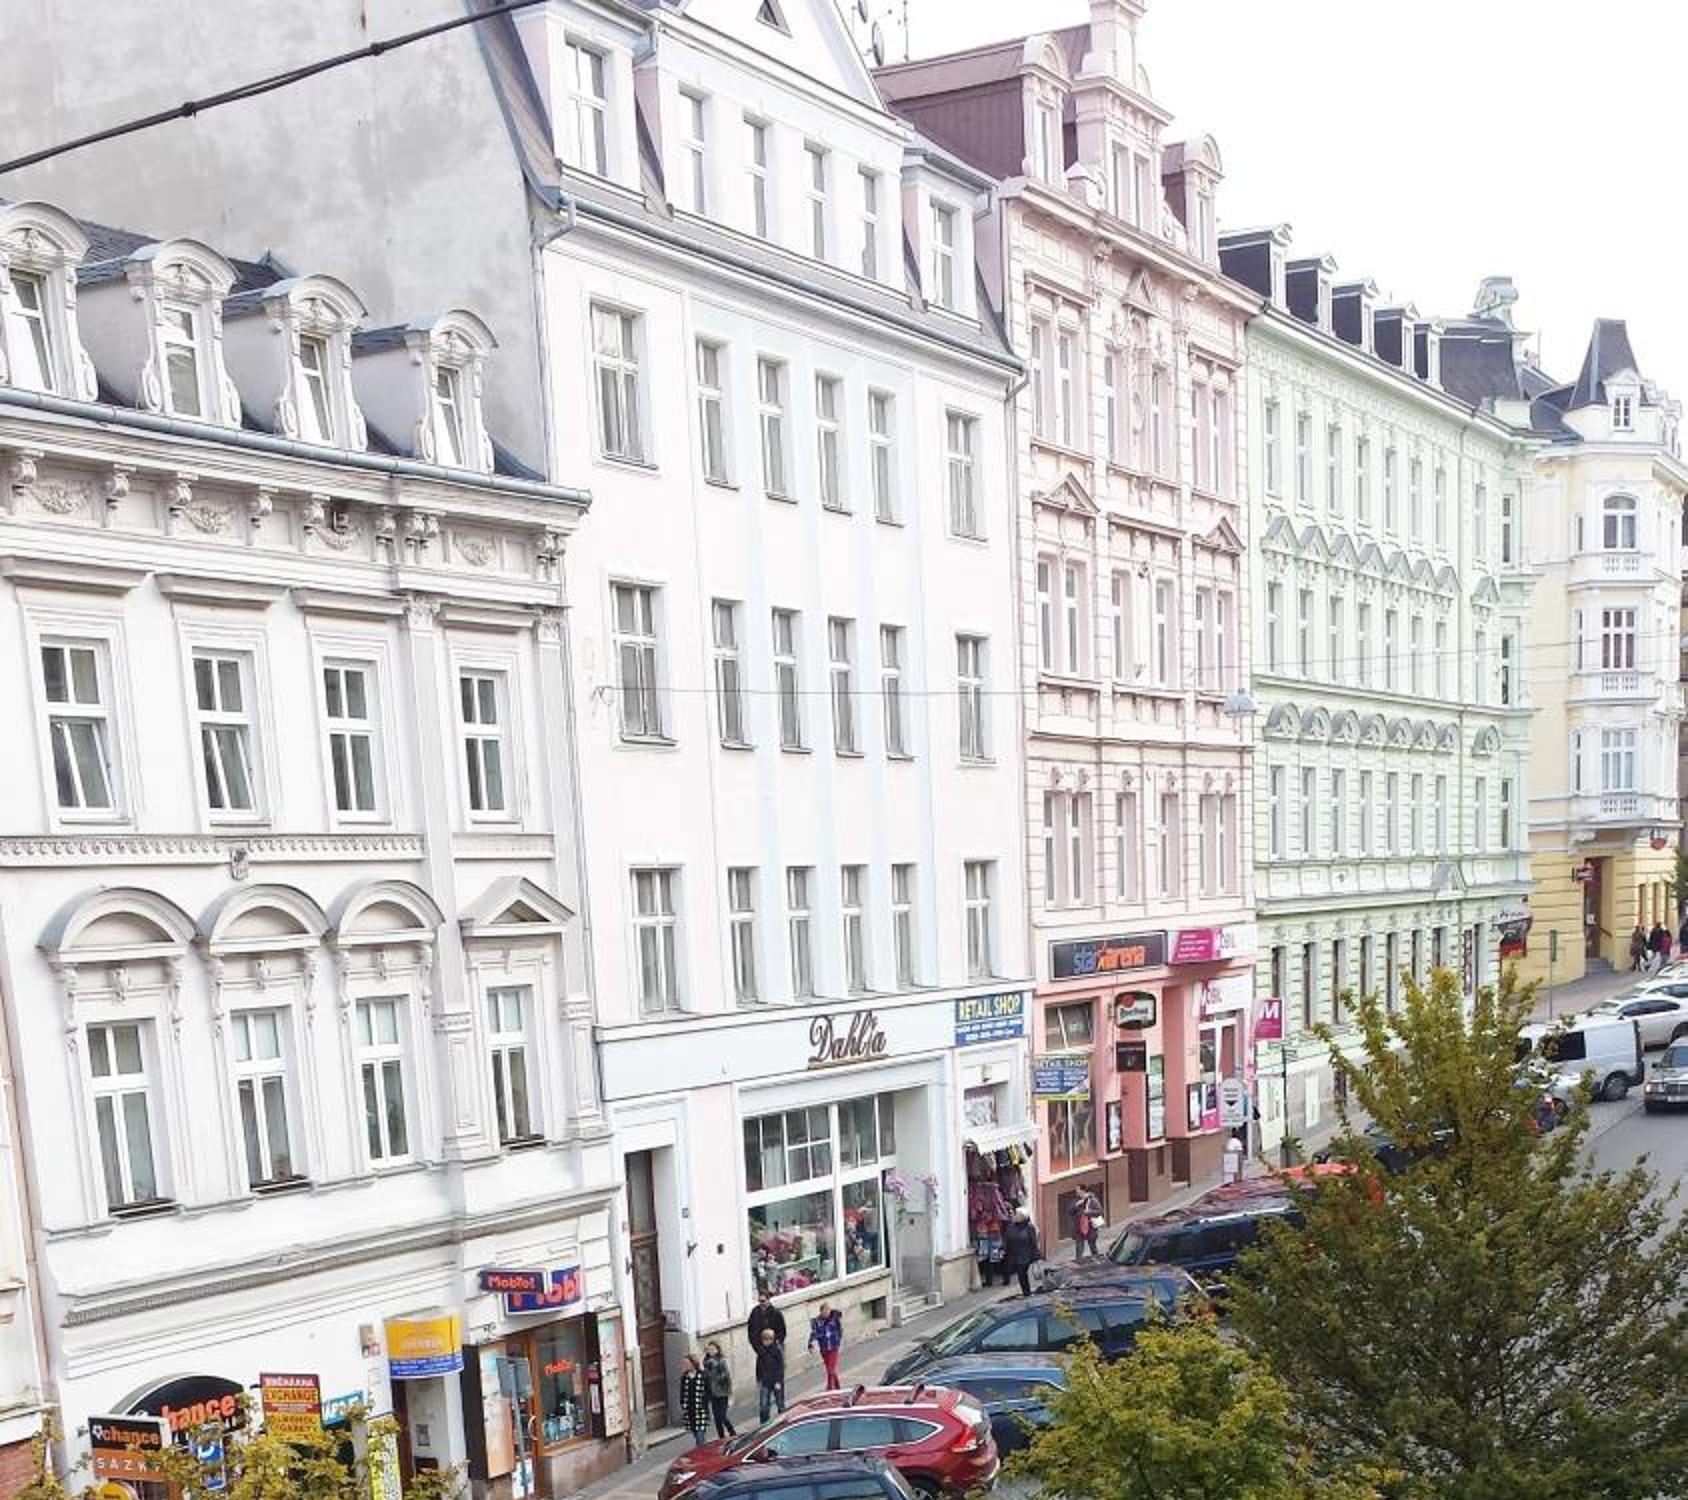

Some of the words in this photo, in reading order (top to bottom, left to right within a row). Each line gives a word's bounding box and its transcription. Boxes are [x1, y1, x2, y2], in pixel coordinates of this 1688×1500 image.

[960, 998, 993, 1021] RETAIL
[993, 993, 1021, 1017] SHOP
[808, 1008, 887, 1062] Dahlia
[264, 1389, 318, 1401] EXCHANGE
[161, 1395, 236, 1432] hance
[103, 1426, 160, 1445] chance
